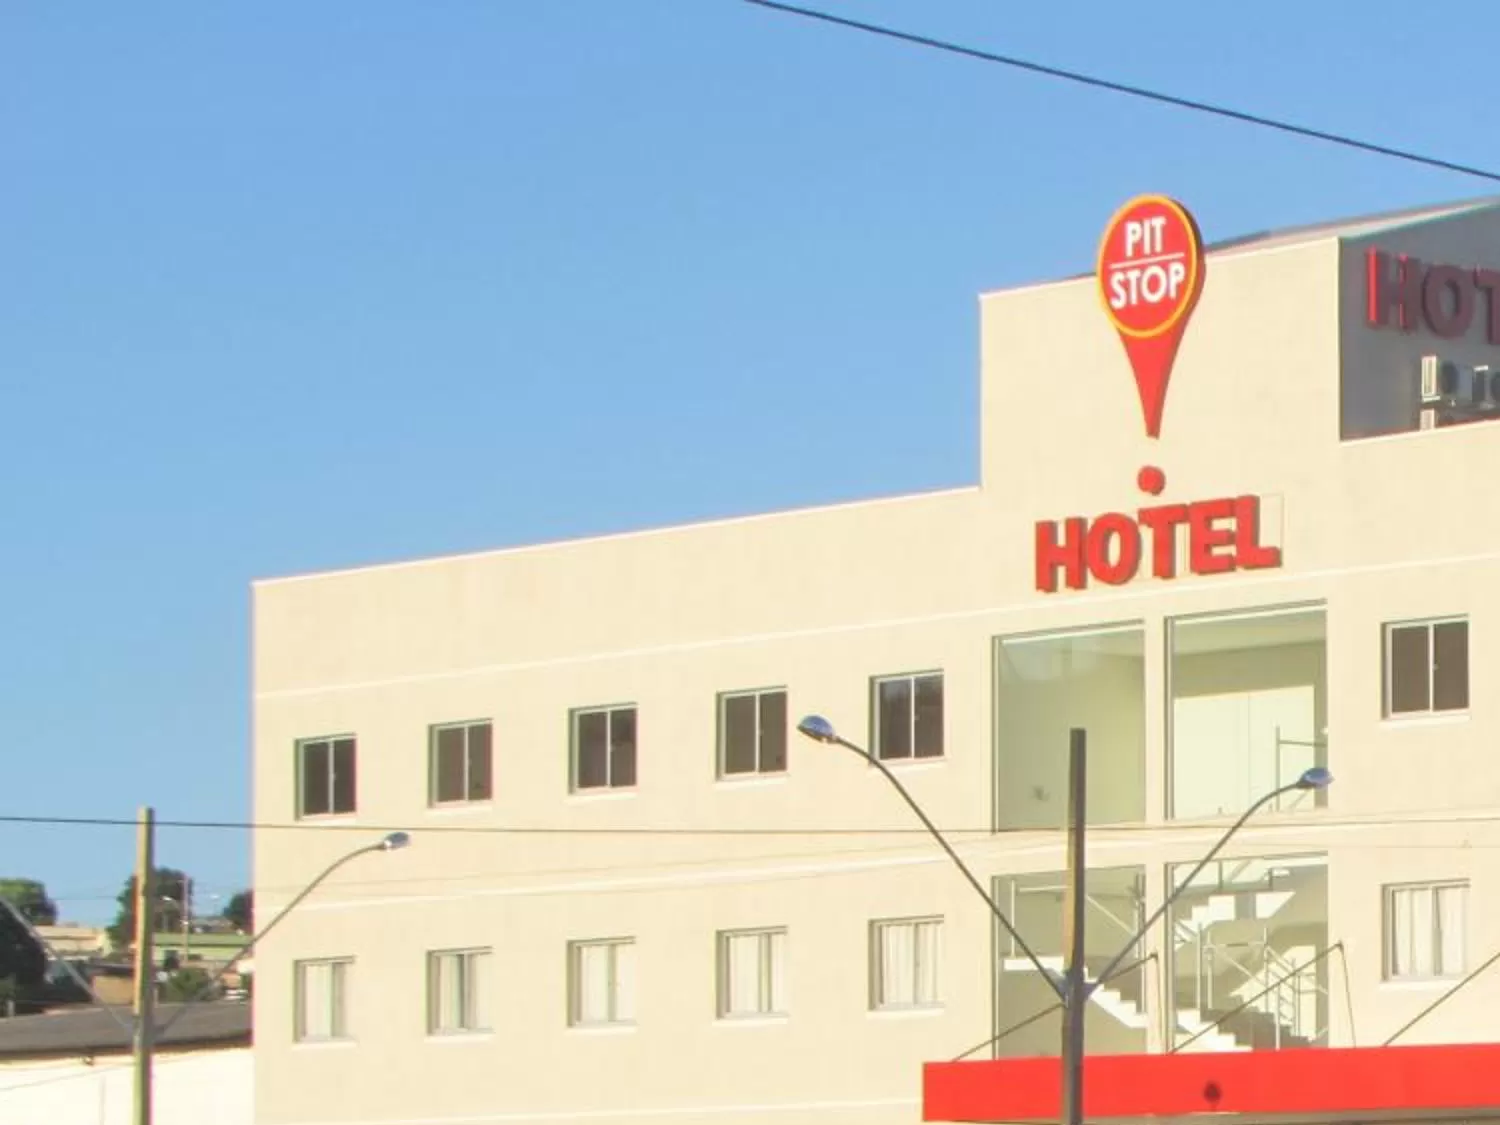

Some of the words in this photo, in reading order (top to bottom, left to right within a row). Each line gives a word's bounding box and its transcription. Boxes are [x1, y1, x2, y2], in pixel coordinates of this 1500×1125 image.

[1125, 216, 1167, 257] PIT
[1110, 261, 1185, 309] STOP
[1035, 494, 1282, 593] HOTEL
